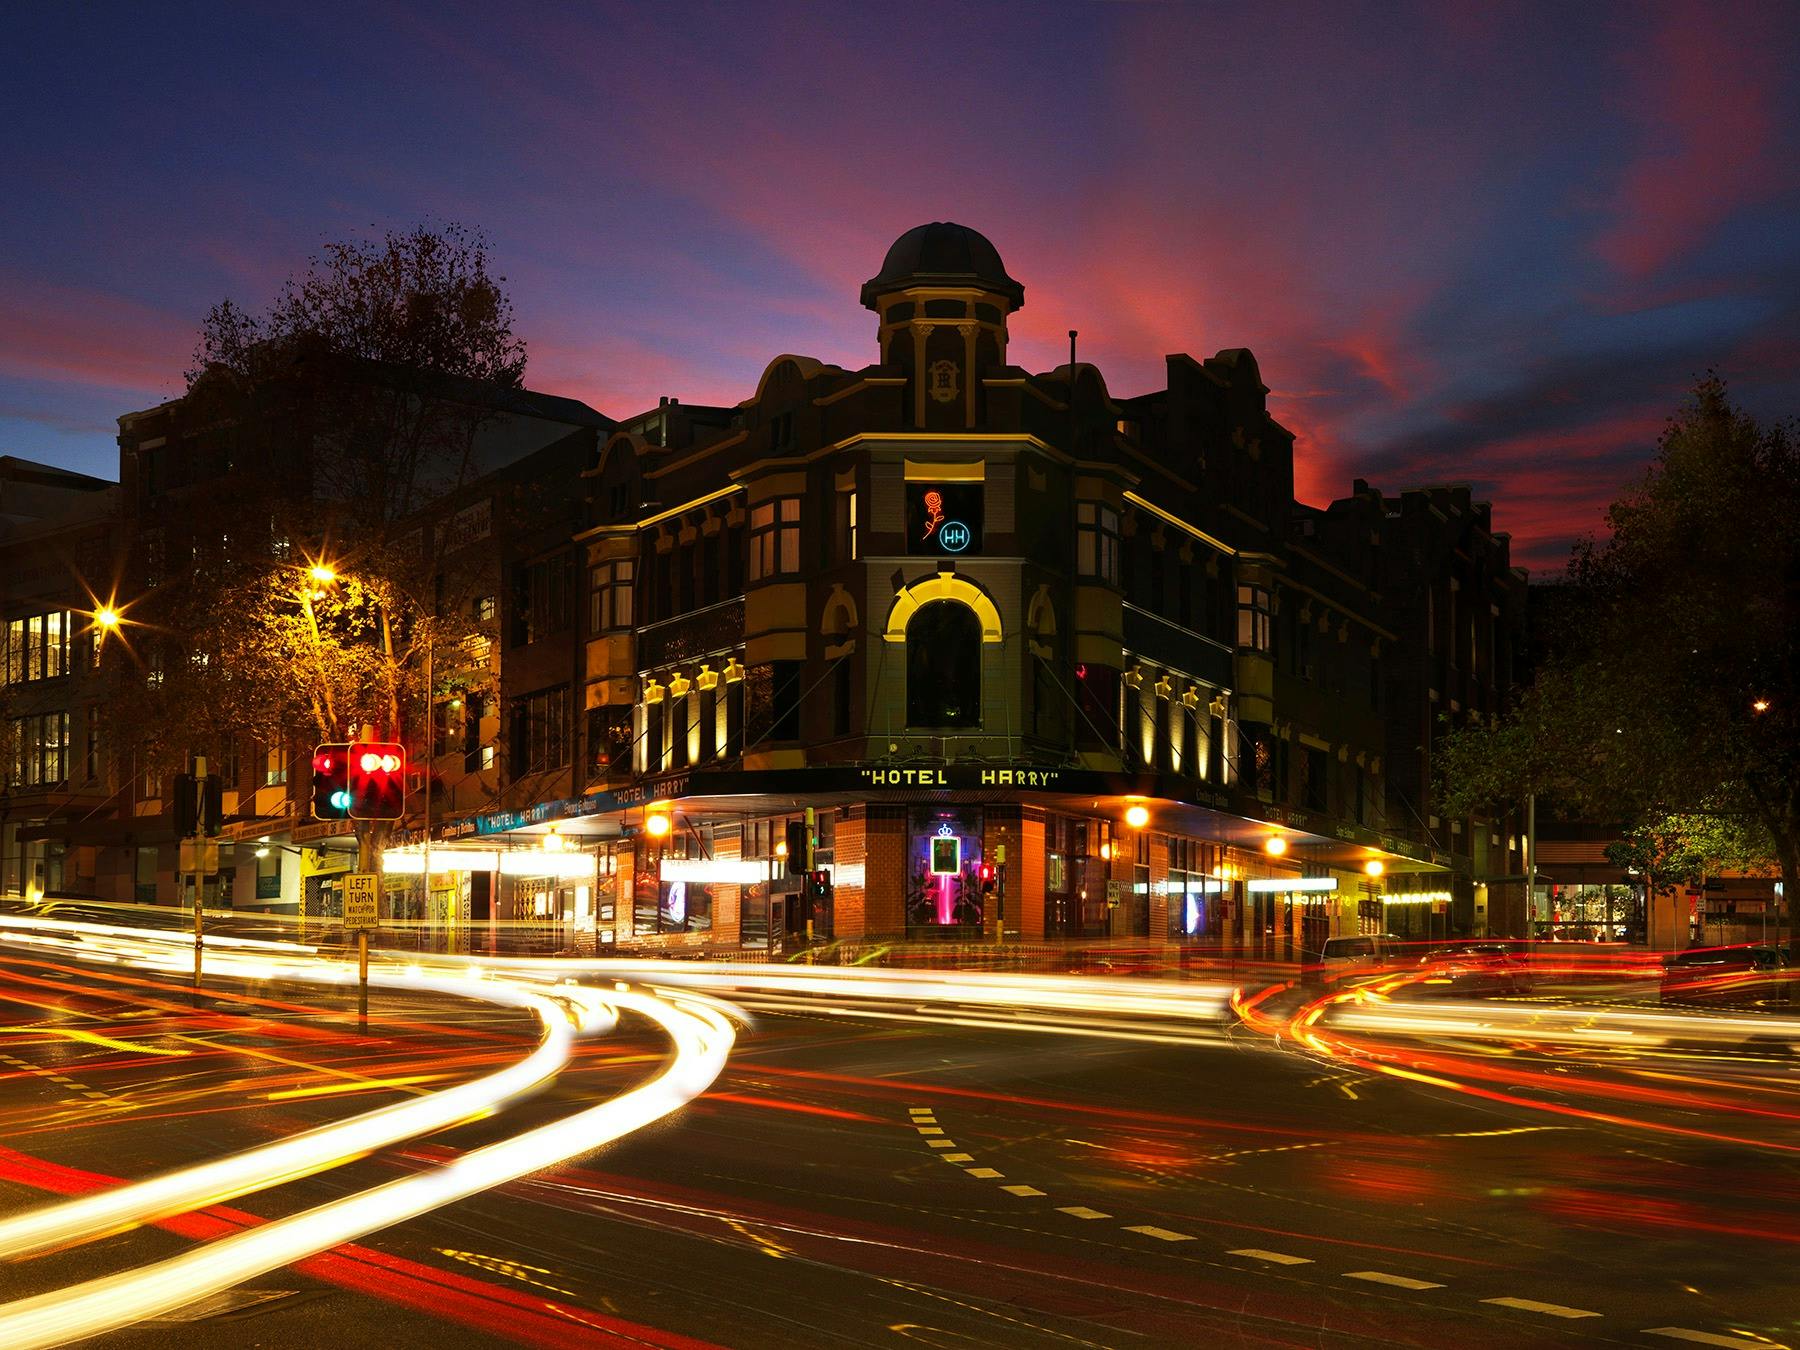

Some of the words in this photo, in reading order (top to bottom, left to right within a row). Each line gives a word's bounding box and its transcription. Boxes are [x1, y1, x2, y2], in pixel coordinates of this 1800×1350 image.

[944, 529, 965, 544] HH
[861, 769, 947, 785] "HOTEL
[981, 769, 1059, 786] HARRY"
[349, 878, 372, 890] LEFT
[349, 892, 374, 903] TURN
[348, 906, 364, 914] WATCH
[345, 916, 377, 925] PEDESTRIANS
